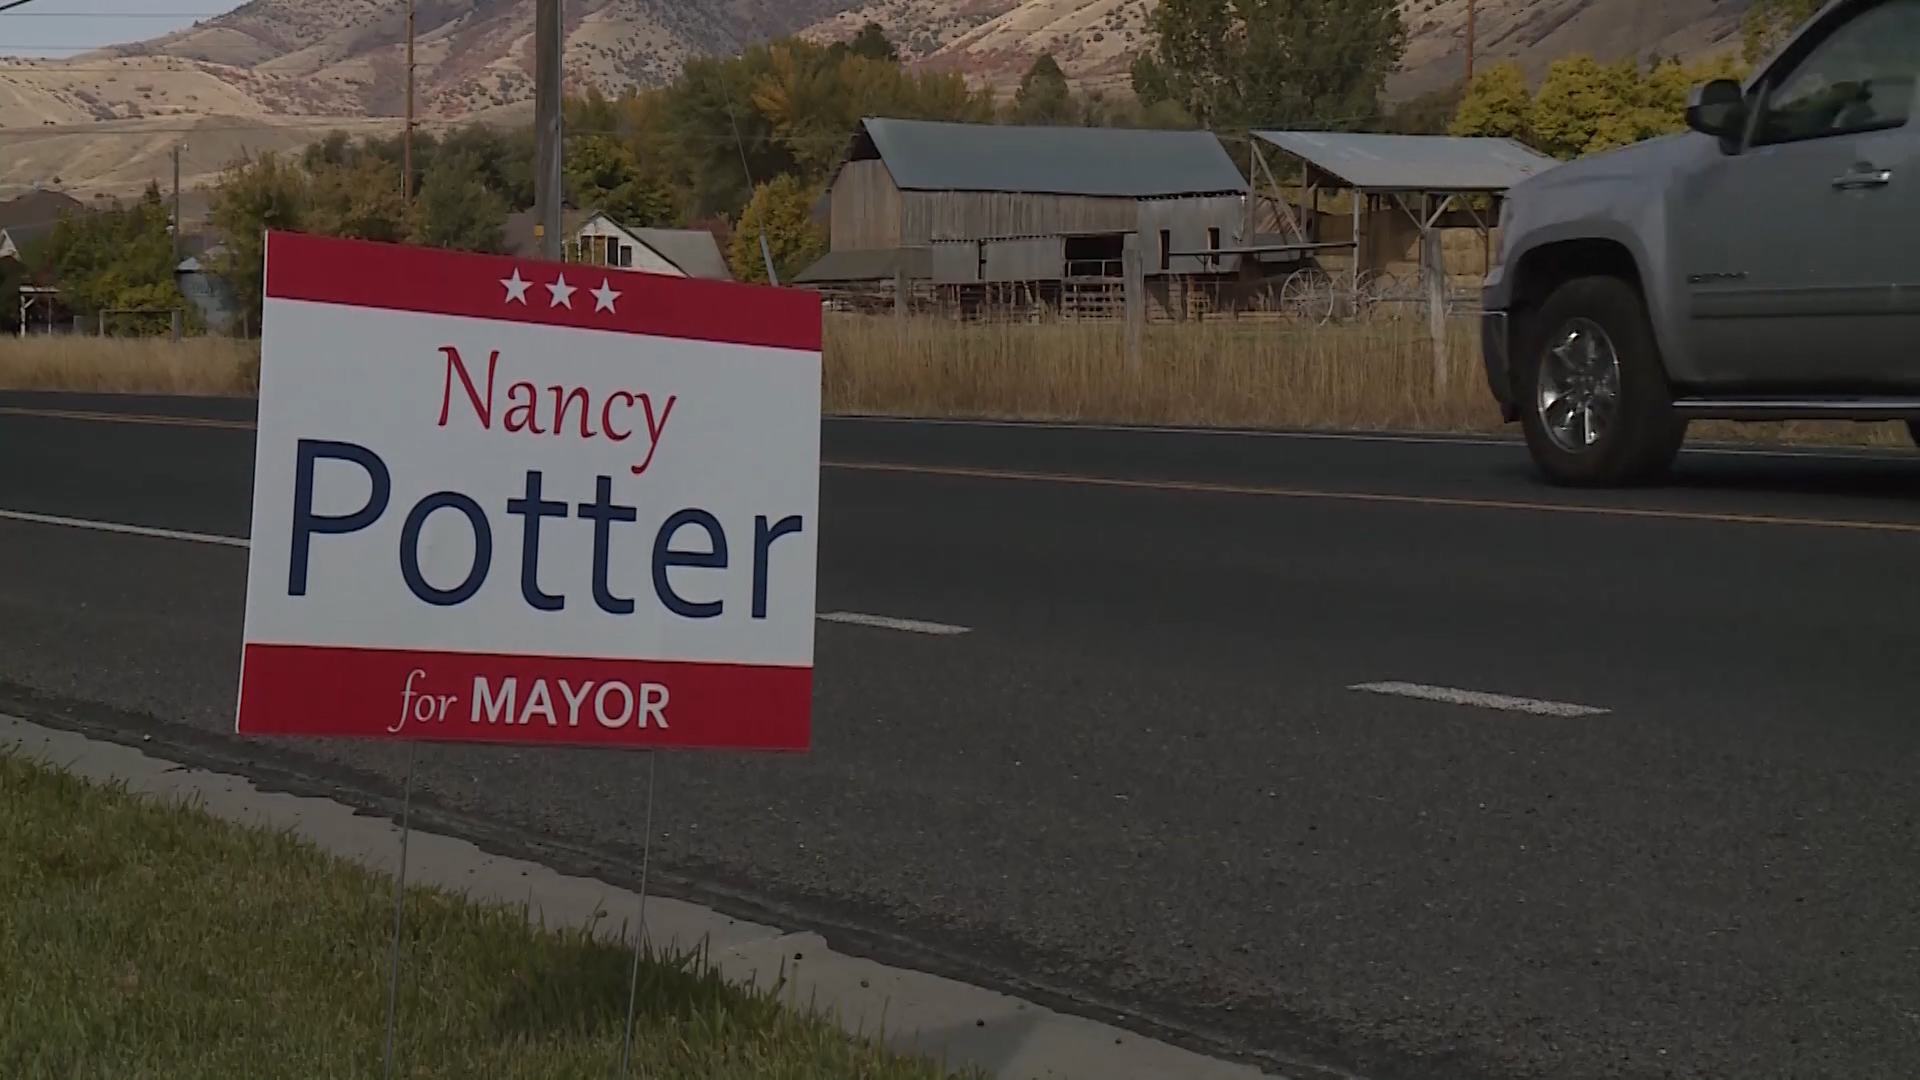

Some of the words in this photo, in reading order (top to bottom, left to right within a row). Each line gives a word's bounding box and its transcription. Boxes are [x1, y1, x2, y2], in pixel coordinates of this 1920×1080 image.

[437, 346, 677, 475] Nancy
[287, 438, 803, 620] Potter
[387, 669, 458, 733] for
[469, 676, 671, 729] MAYOR
